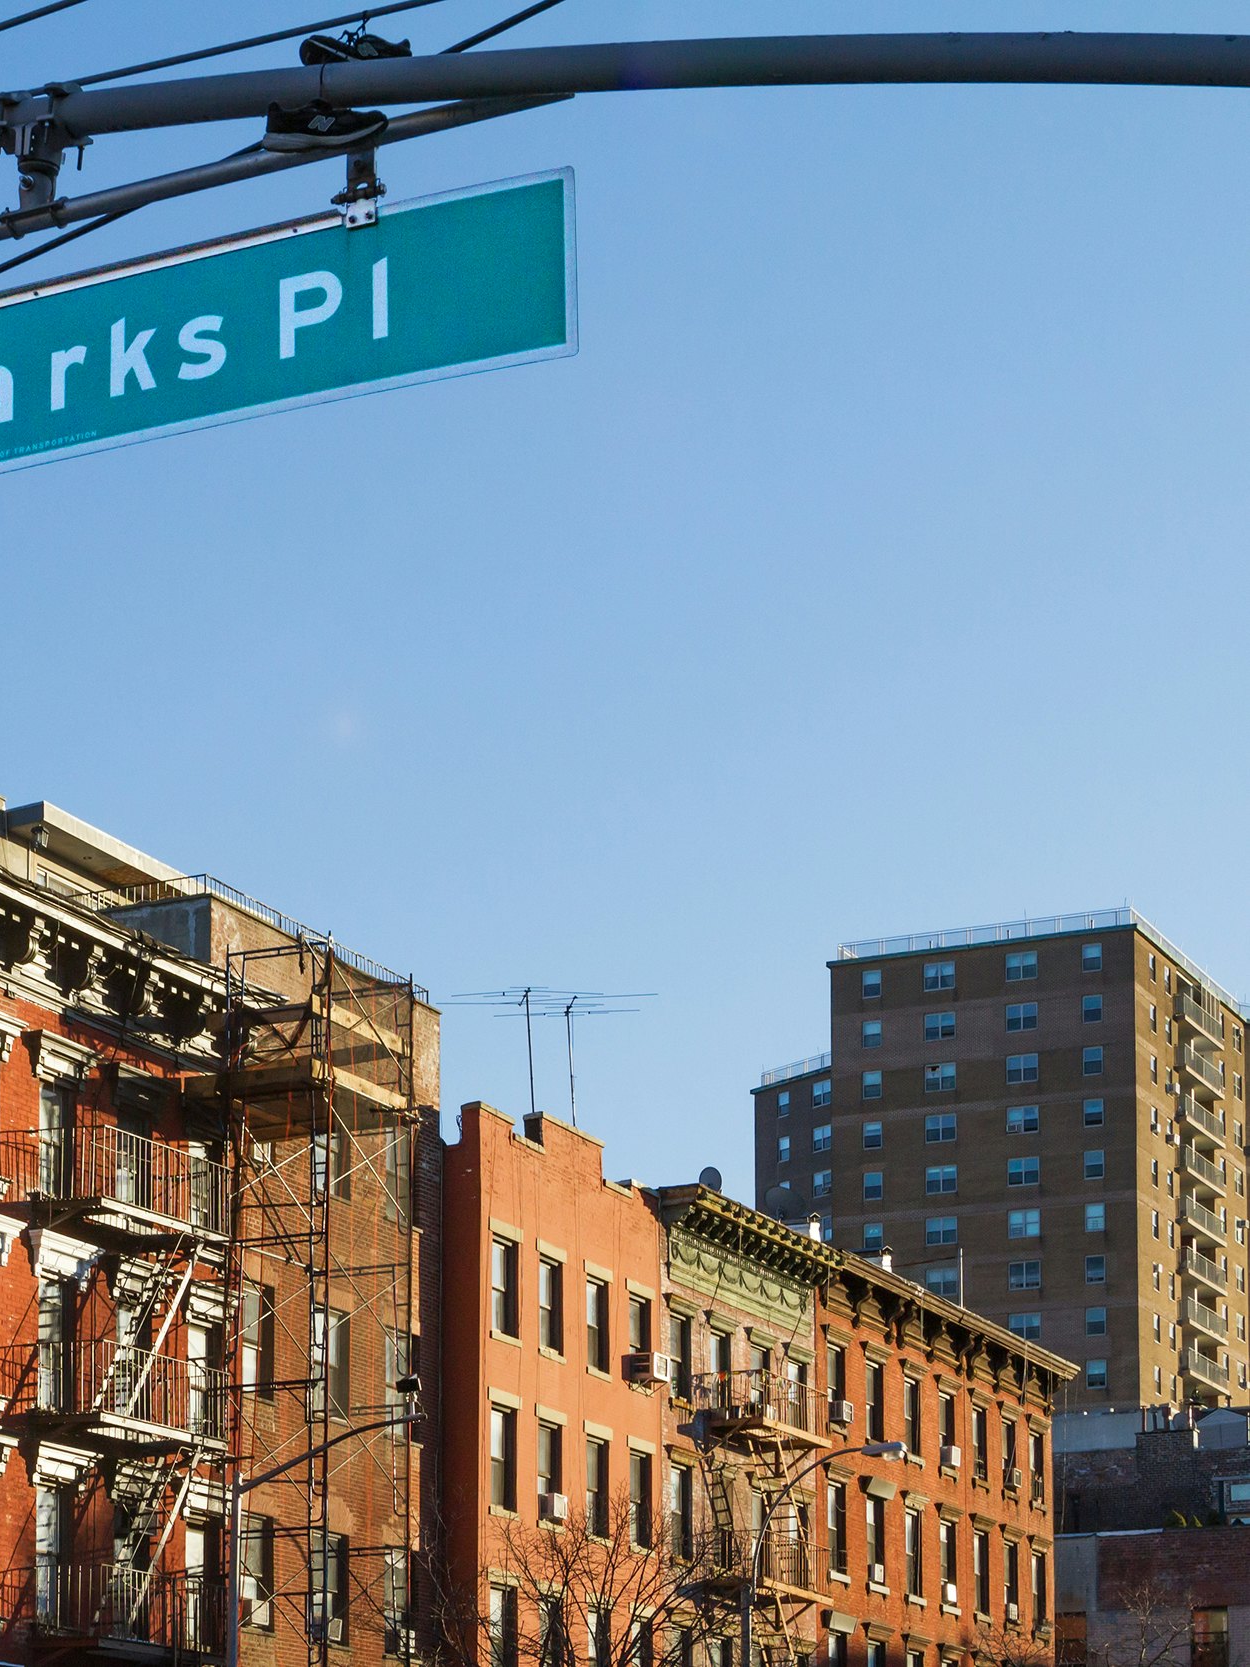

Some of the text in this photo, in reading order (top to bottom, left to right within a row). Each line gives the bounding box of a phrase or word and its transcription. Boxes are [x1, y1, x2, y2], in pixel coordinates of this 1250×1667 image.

[308, 115, 335, 132] N
[280, 257, 388, 359] Pl
[0, 448, 10, 458] OF
[14, 430, 97, 454] TRANSPORTATION
